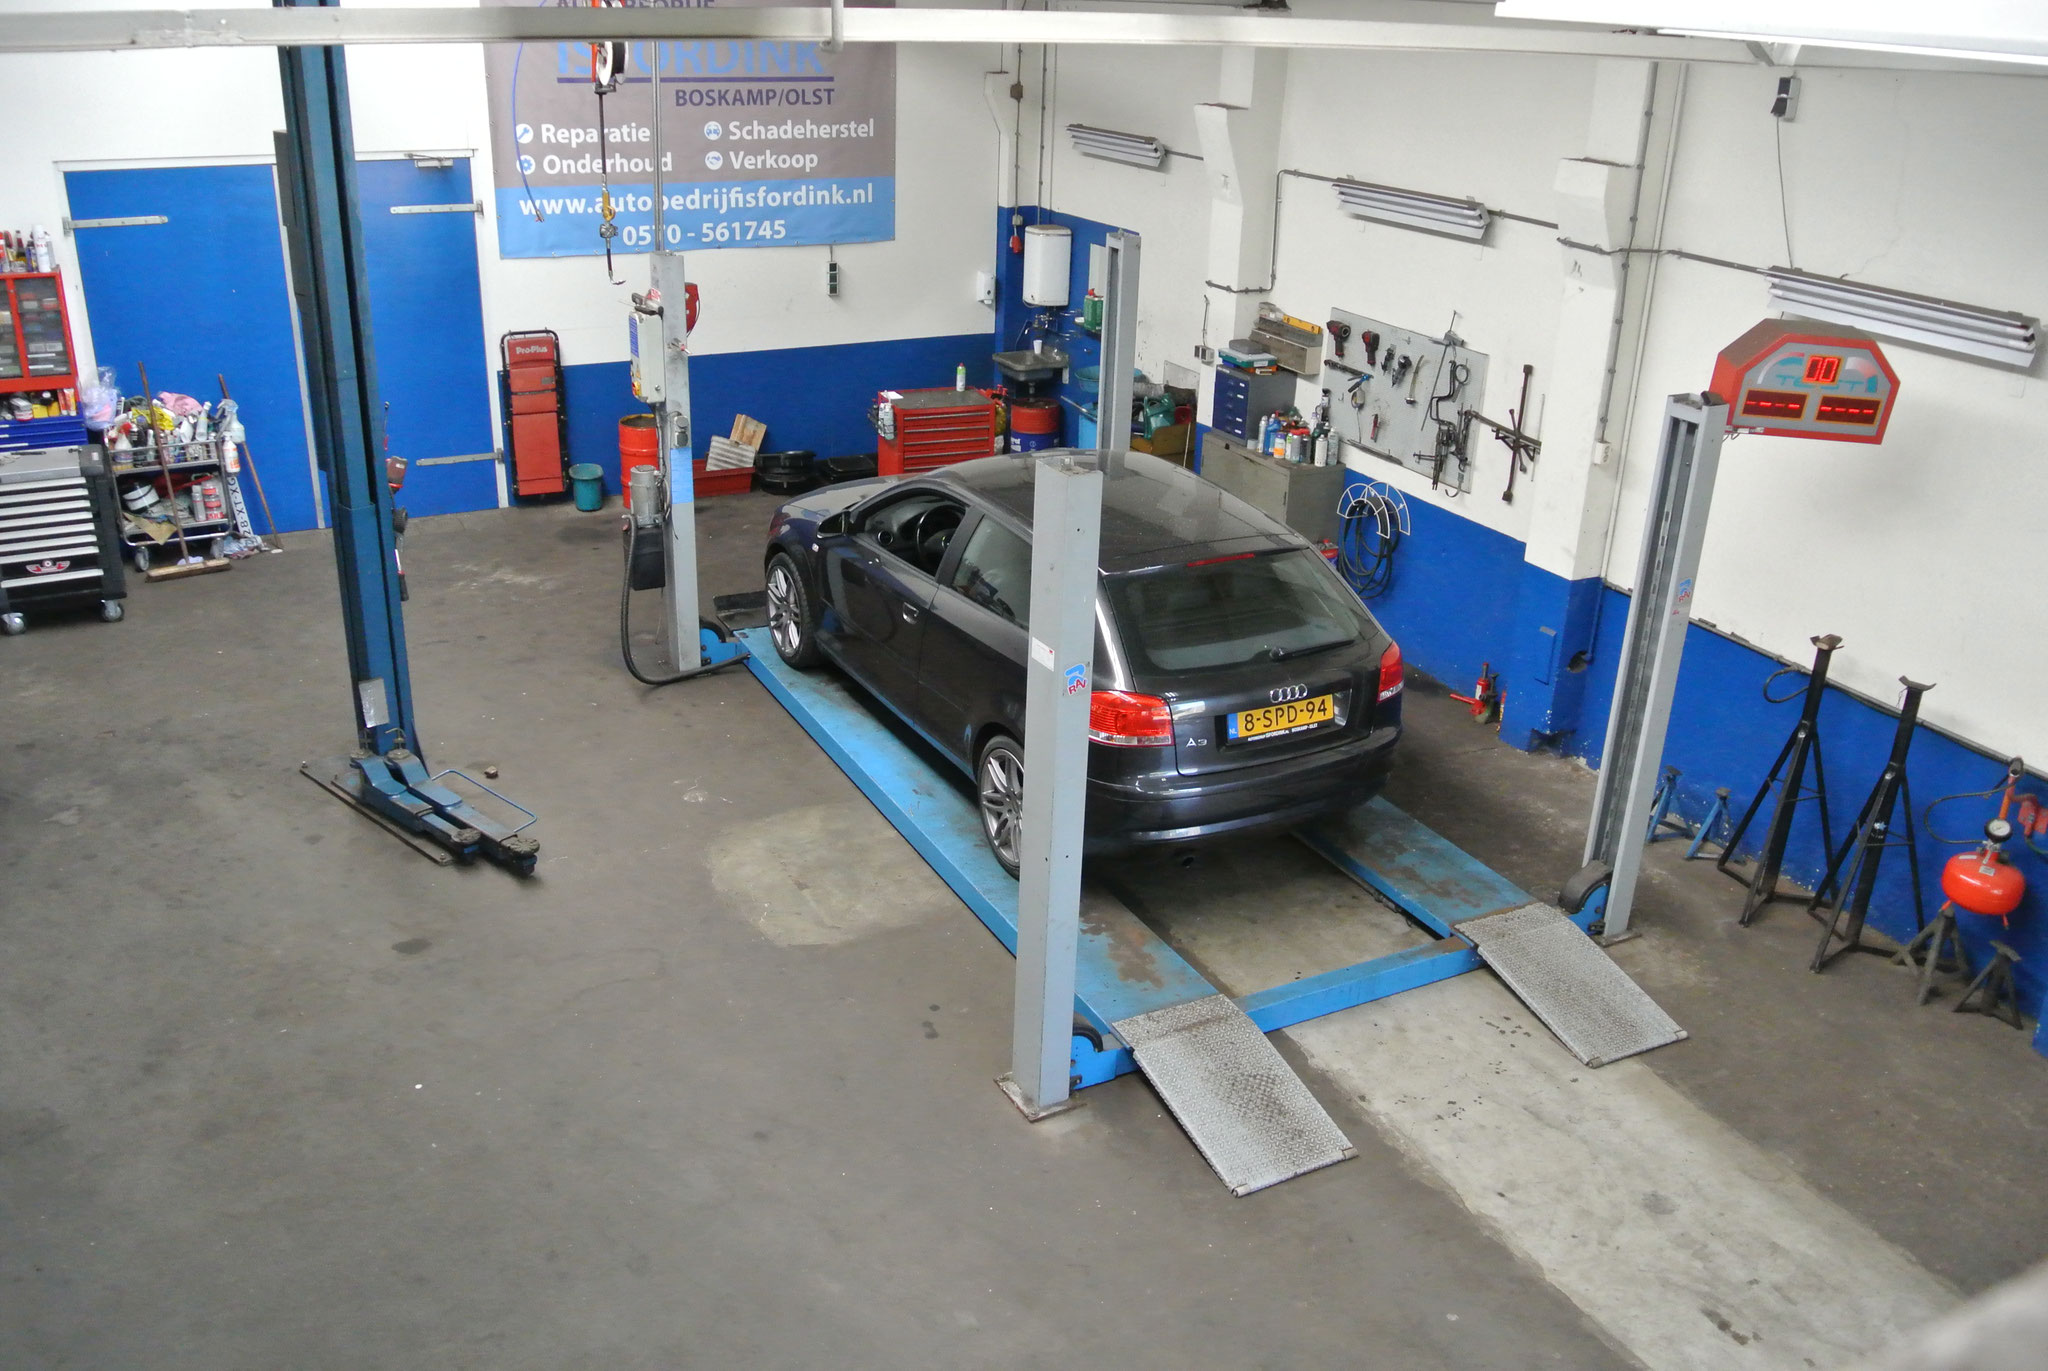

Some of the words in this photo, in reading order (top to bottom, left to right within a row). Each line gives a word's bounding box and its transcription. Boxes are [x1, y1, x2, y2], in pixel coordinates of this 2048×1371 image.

[557, 41, 824, 74] ISORDINK
[675, 88, 835, 106] BOSKAMP/OLST
[728, 118, 874, 140] Schadeherstel
[543, 152, 673, 175] Onderhoud
[729, 149, 819, 172] Verkoop
[622, 224, 682, 246] 050
[702, 219, 787, 242] 561745
[1244, 698, 1328, 732] 8-SPD-94
[1186, 738, 1208, 748] A3
